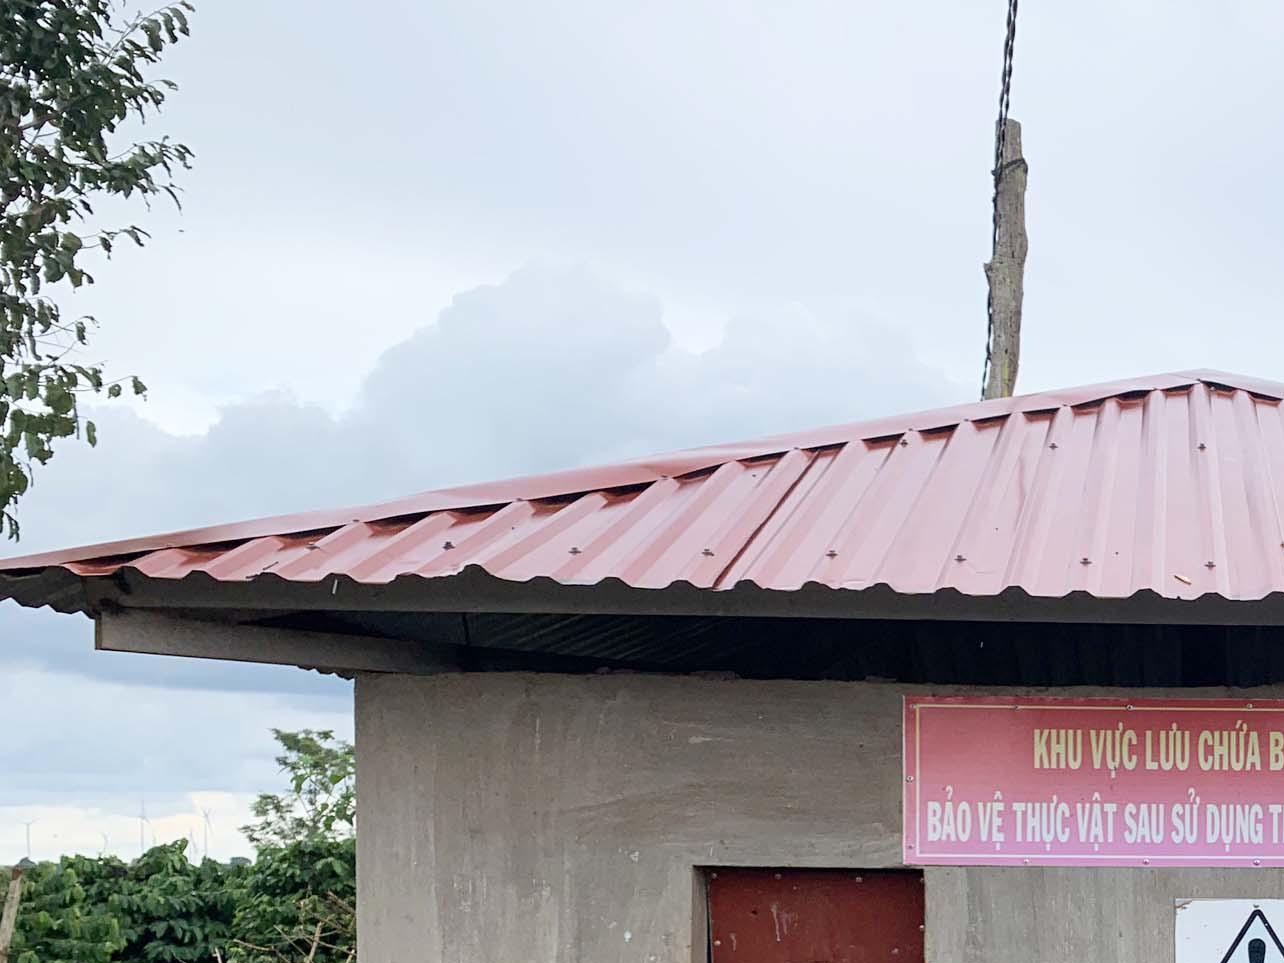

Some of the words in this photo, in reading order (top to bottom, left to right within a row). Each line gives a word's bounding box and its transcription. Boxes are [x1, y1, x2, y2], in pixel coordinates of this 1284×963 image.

[1033, 729, 1082, 770] KHU
[1090, 722, 1137, 778] VỰC
[1145, 722, 1190, 770] LƯU
[1198, 720, 1261, 771] CHỨA
[927, 785, 971, 842] BẢO
[977, 791, 1005, 851] VỆ
[1012, 795, 1070, 851] THỰC
[1076, 792, 1117, 851] VẬT
[1124, 803, 1164, 843] SAU
[1171, 787, 1200, 843] SỬ
[1207, 803, 1263, 852] DỤNG
